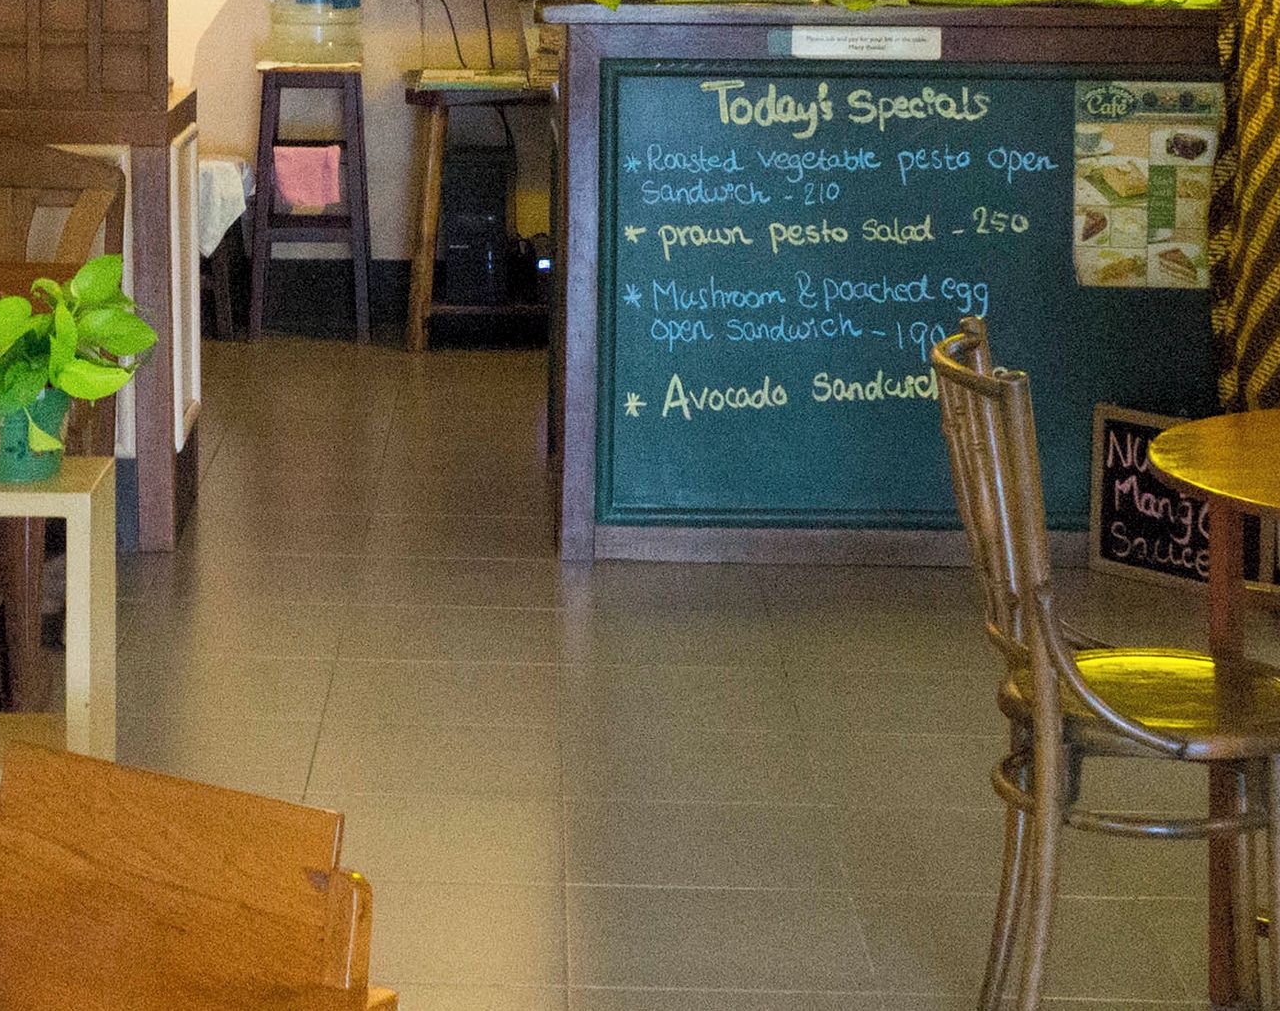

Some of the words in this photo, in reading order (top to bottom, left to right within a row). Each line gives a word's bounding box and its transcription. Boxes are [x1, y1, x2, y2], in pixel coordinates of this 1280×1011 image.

[700, 79, 833, 139] Today's
[847, 86, 991, 132] Specials
[646, 143, 745, 174] Roasted
[757, 148, 881, 183] vegetable
[898, 144, 971, 186] pesto
[804, 182, 840, 206] 210
[769, 219, 849, 254] pesto
[972, 206, 1029, 234] 250
[652, 276, 786, 312] Mushroom
[823, 274, 935, 312] poached
[941, 277, 989, 318] egg
[662, 373, 788, 421] Avocado
